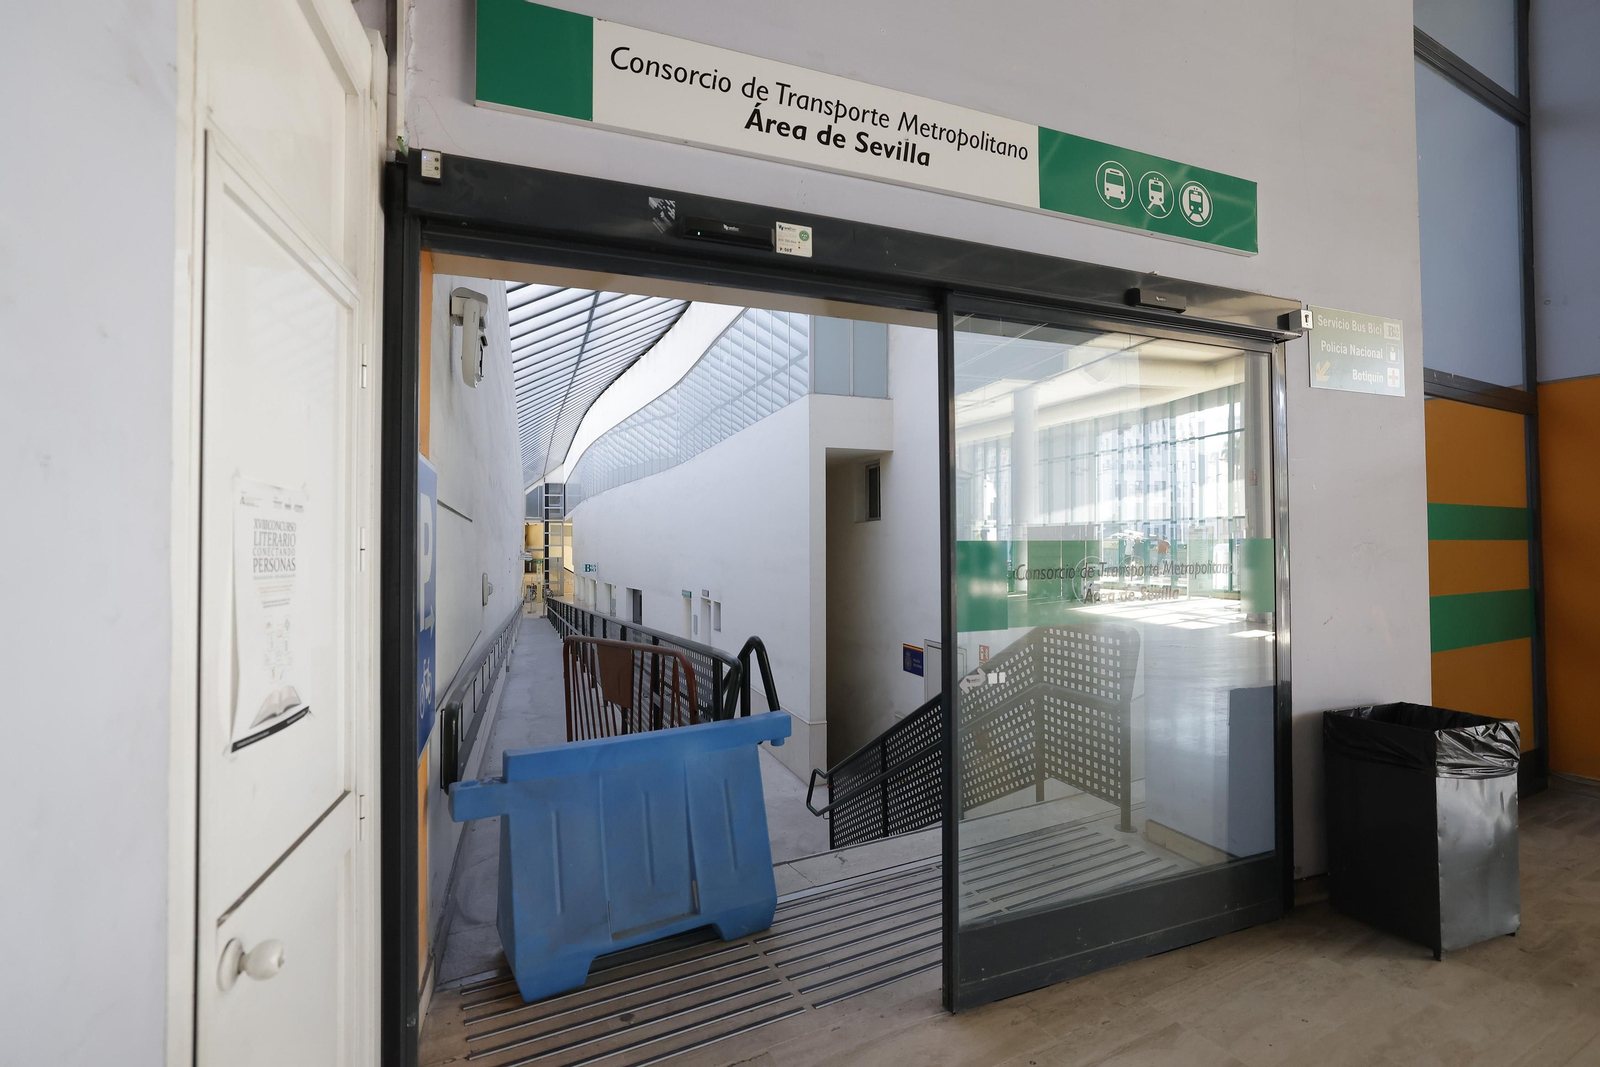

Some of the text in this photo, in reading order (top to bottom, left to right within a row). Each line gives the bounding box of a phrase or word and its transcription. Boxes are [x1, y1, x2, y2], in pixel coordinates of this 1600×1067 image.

[610, 46, 1029, 161] Consorcio de Transporte Metropolitano
[744, 102, 931, 166] Área de Sevilla
[1317, 315, 1350, 330] Servicio
[1351, 320, 1366, 333] Bus
[1368, 322, 1382, 335] Bici
[1321, 340, 1383, 359] Policía Nacional
[1352, 369, 1384, 384] Botiquín
[267, 519, 297, 532] CONCURSO
[253, 531, 297, 548] LITERARIO
[252, 547, 296, 557] CONECTANDO
[252, 557, 297, 573] PERSONAS
[1016, 563, 1076, 581] Consorcio
[1080, 562, 1094, 579] de
[1099, 561, 1160, 581] Transporte
[1083, 583, 1180, 604] Área de Sevilla
